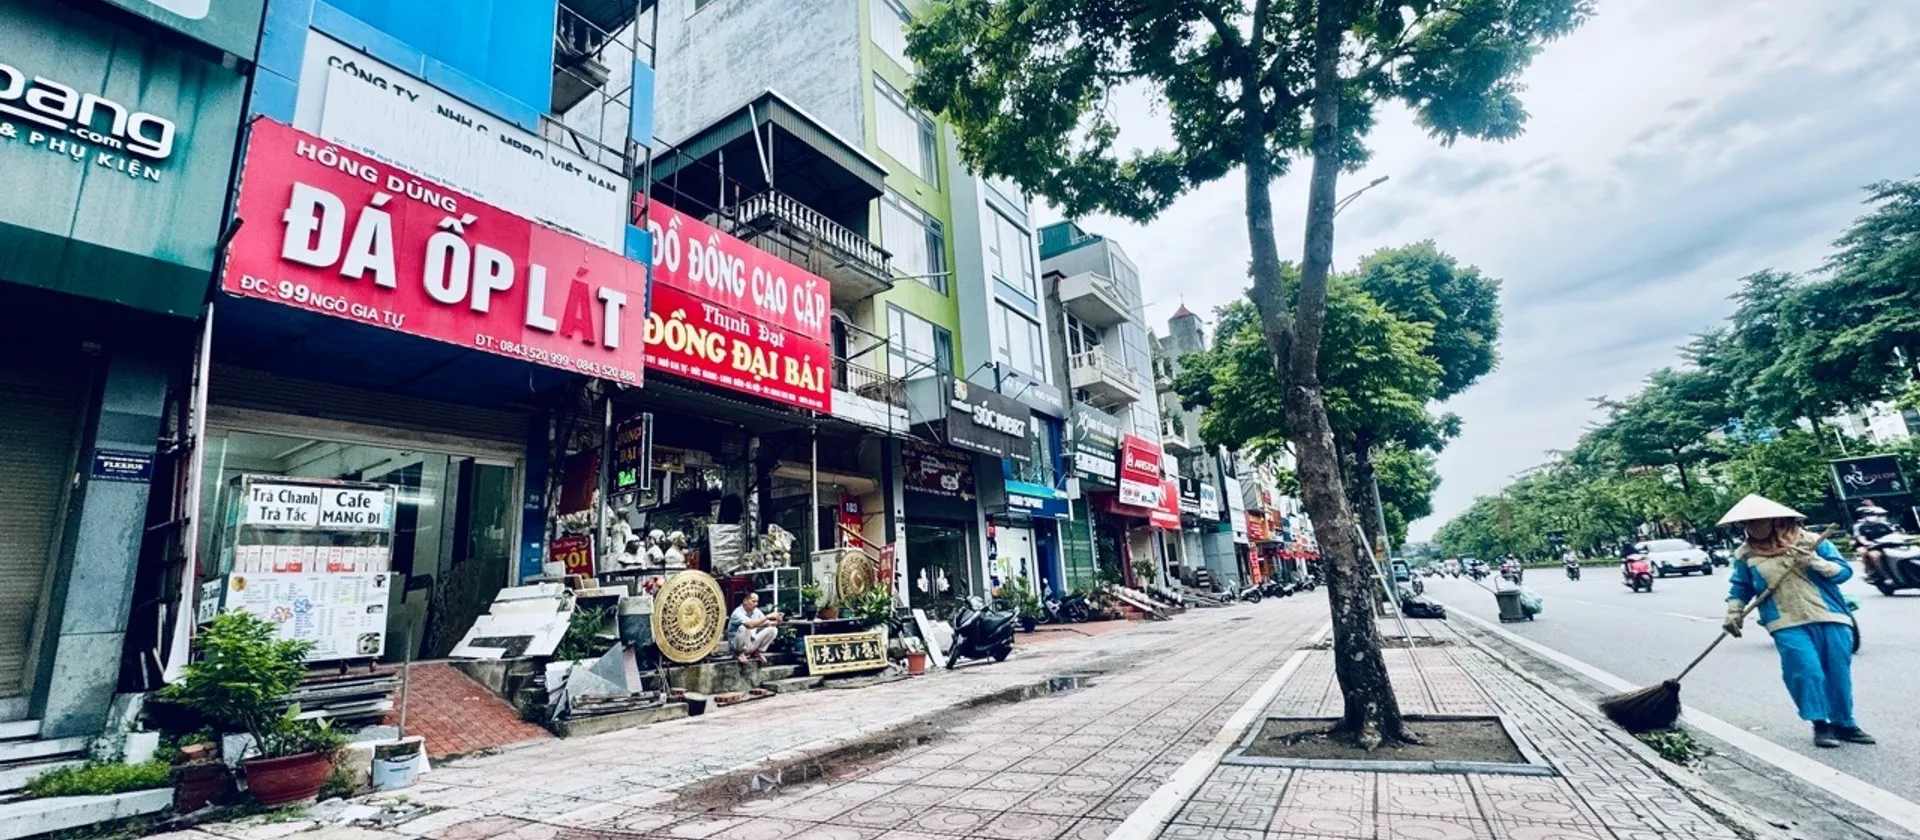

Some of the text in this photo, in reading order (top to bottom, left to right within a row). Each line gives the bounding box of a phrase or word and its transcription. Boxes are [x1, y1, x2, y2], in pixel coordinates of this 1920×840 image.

[69, 128, 122, 149] .com
[29, 130, 88, 163] PHỤ
[96, 151, 161, 183] KIỆN
[296, 139, 458, 213] HỒNG DŨNG
[281, 180, 628, 350] ĐÁ ỐP LÁT
[645, 214, 682, 273] ĐỒ
[687, 233, 747, 299] ĐỒNG
[751, 265, 789, 316] CAO
[792, 280, 826, 330] CẤP
[350, 302, 379, 322] GIA
[382, 310, 406, 329] TỰ
[701, 302, 787, 348] Thịnh Đạt
[499, 339, 527, 357] 0843
[529, 346, 548, 361] 520
[550, 352, 569, 366] 999
[575, 358, 600, 374] 0843
[642, 307, 728, 364] ĐỒNG
[730, 339, 779, 382] ĐẠI
[252, 487, 319, 506] Trà Chanh
[259, 506, 281, 521] Trà
[335, 491, 372, 509] Cafe
[321, 509, 381, 525] MANG ĐI
